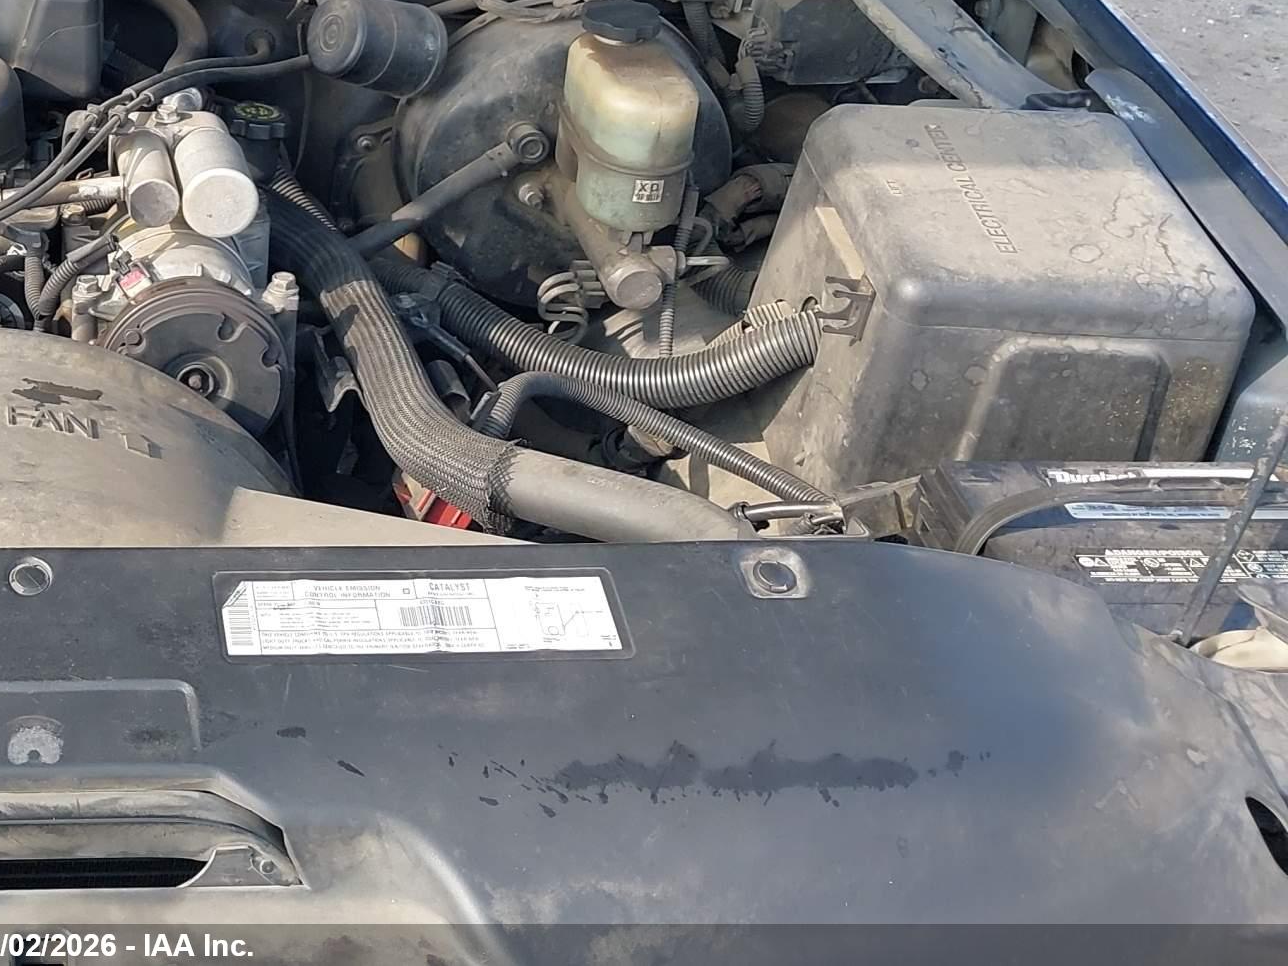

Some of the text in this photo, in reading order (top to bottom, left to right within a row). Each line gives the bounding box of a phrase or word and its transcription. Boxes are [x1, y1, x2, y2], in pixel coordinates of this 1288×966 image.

[956, 175, 1018, 254] ELECTRICAL
[6, 403, 100, 440] FAN
[429, 582, 470, 592] CATALYST
